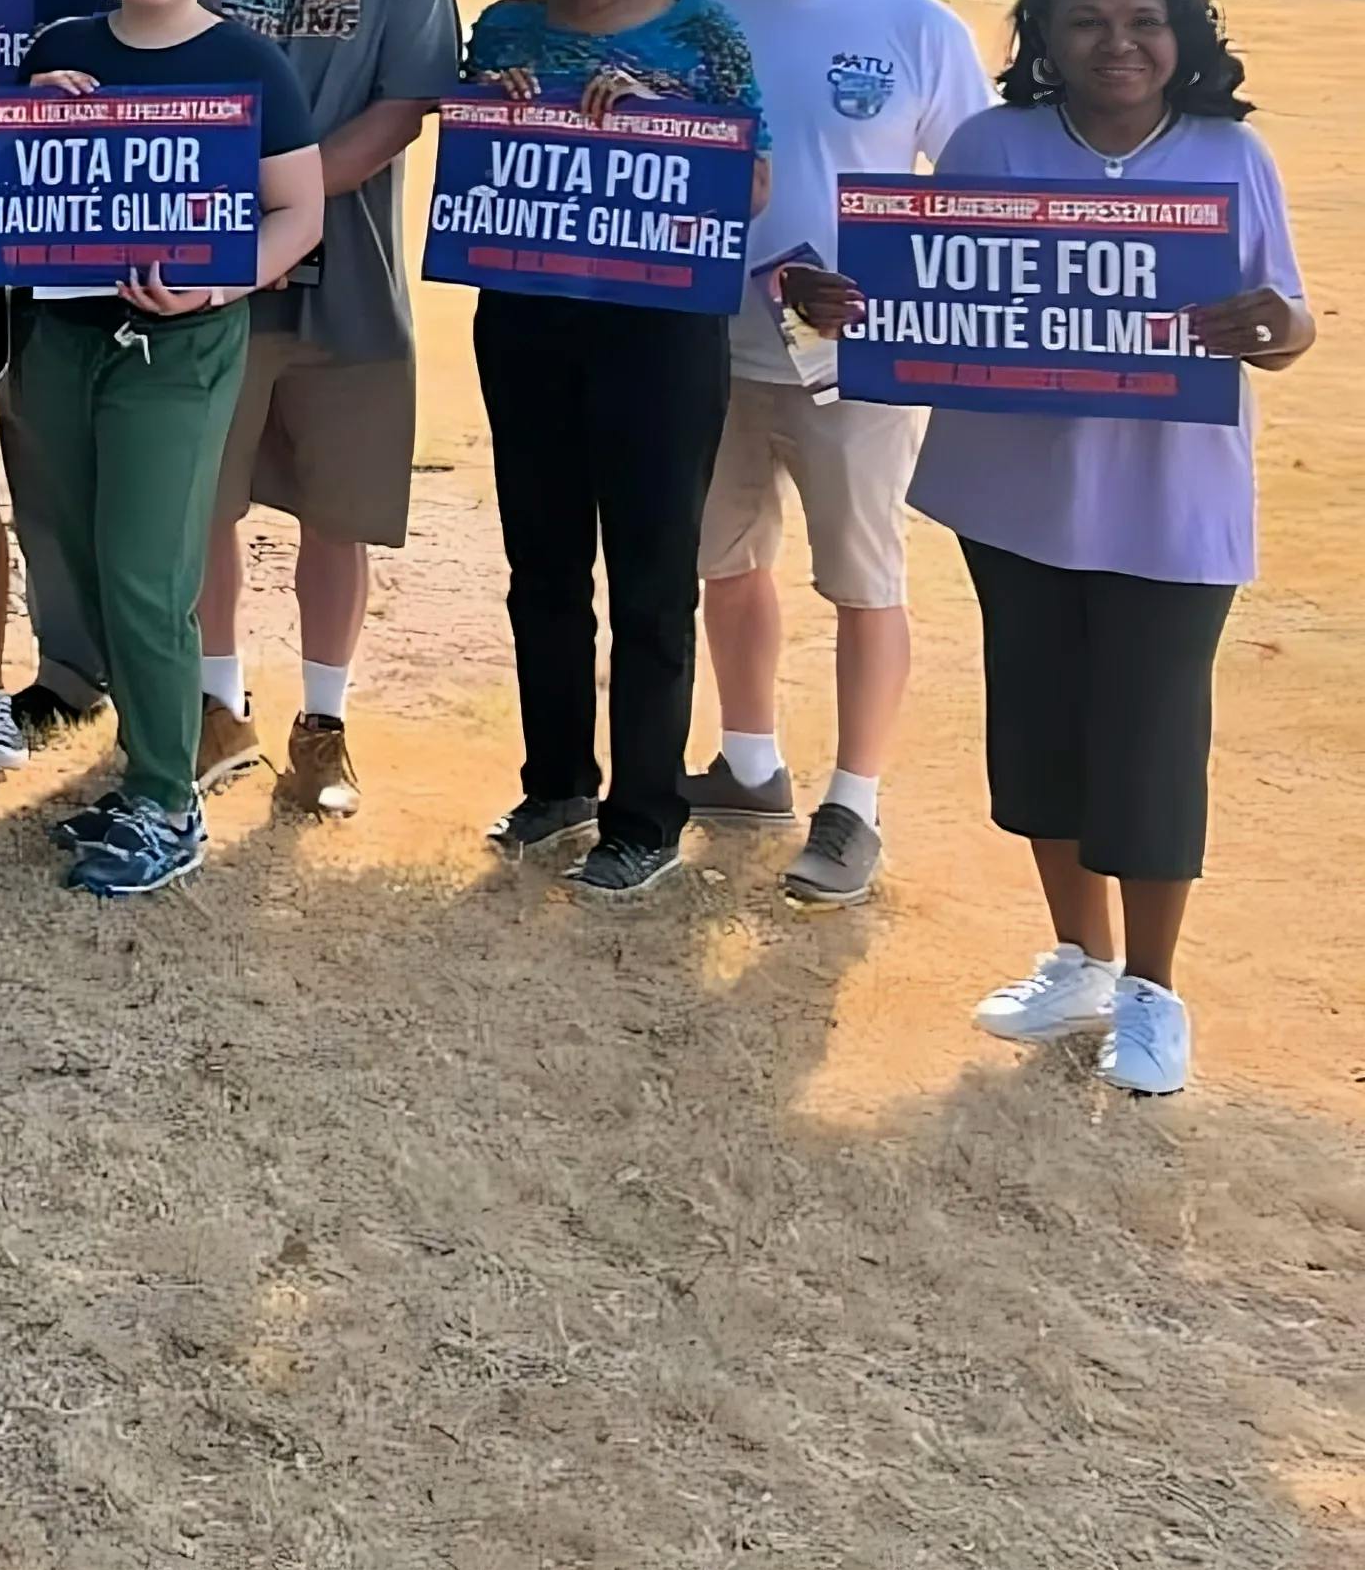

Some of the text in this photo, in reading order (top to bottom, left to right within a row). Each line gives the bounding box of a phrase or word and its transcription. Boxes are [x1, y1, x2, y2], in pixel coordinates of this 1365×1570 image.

[15, 136, 200, 186] VOTA POR
[491, 140, 690, 204] VOTA POR
[111, 192, 254, 232] GILMORE
[432, 193, 744, 260] CHAUNTÉ GILMORE
[911, 234, 1157, 299] VOTE FOR
